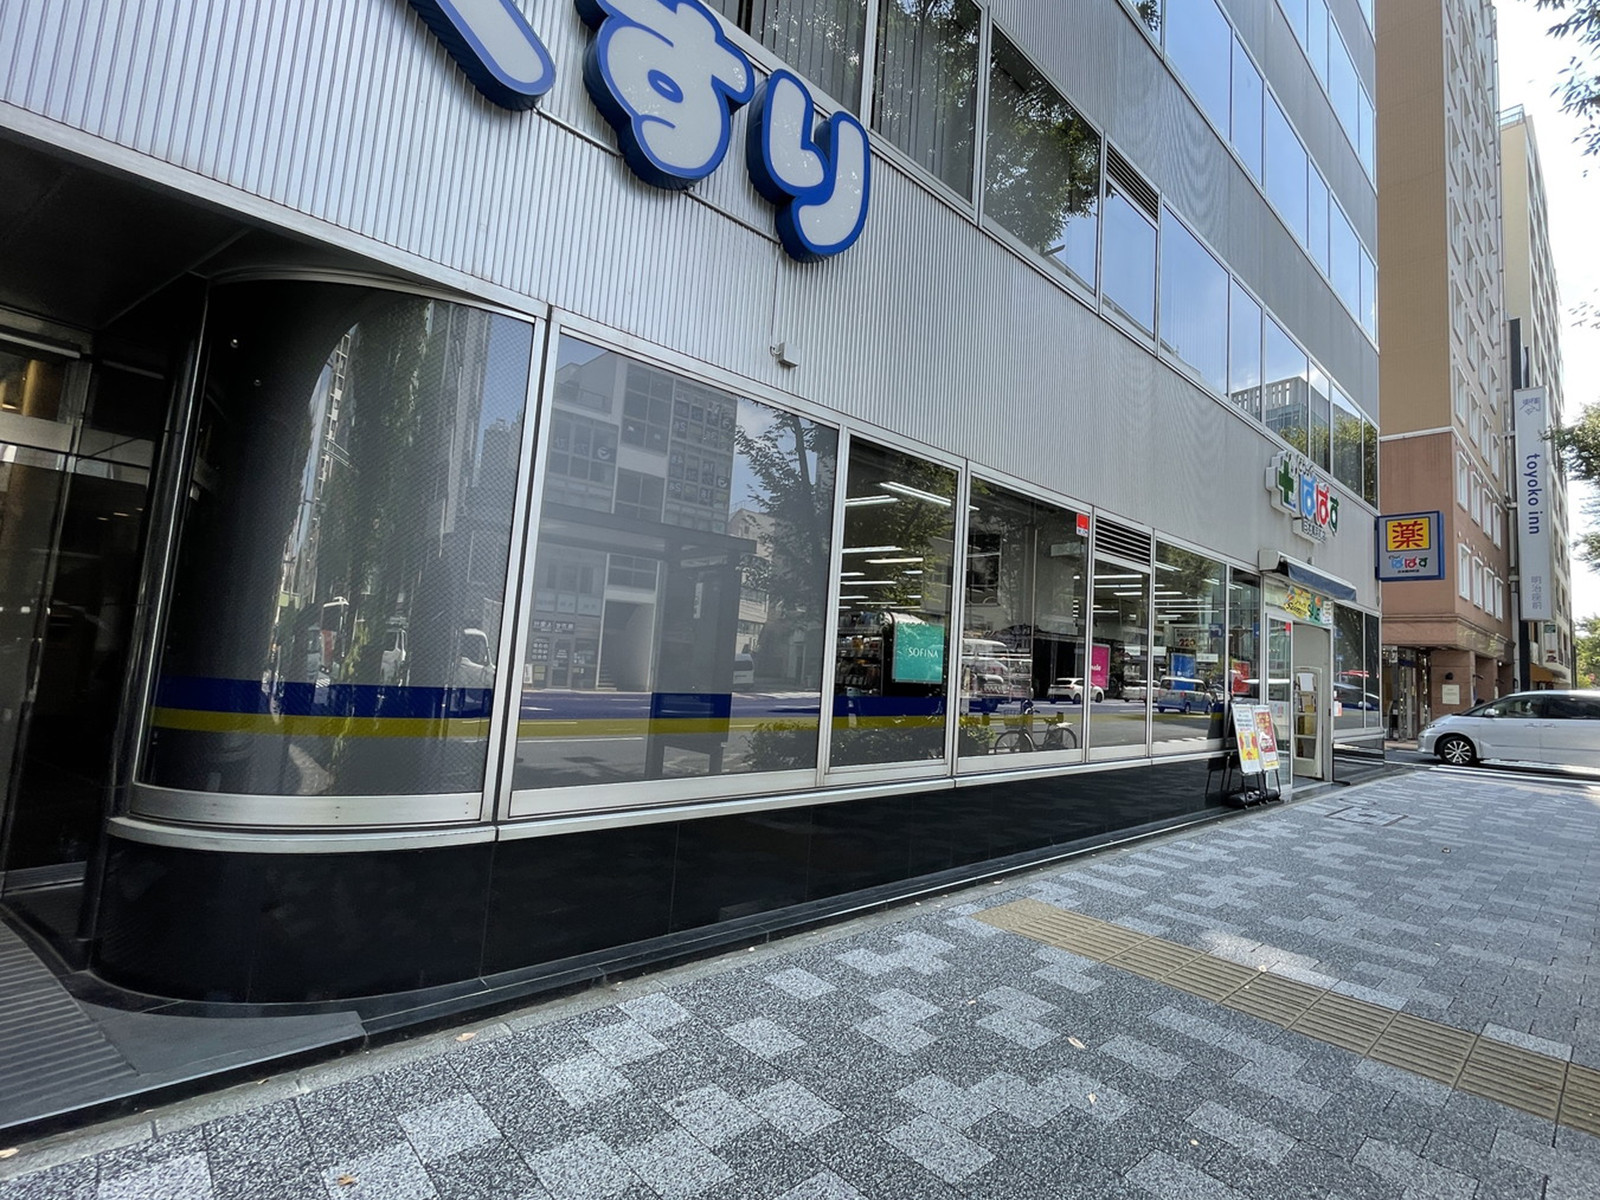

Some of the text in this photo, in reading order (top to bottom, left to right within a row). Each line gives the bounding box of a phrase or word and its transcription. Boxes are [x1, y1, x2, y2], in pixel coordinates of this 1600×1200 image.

[1524, 453, 1544, 535] toyoko inn
[1392, 520, 1424, 549] 薬
[908, 647, 939, 658] SOFINA
